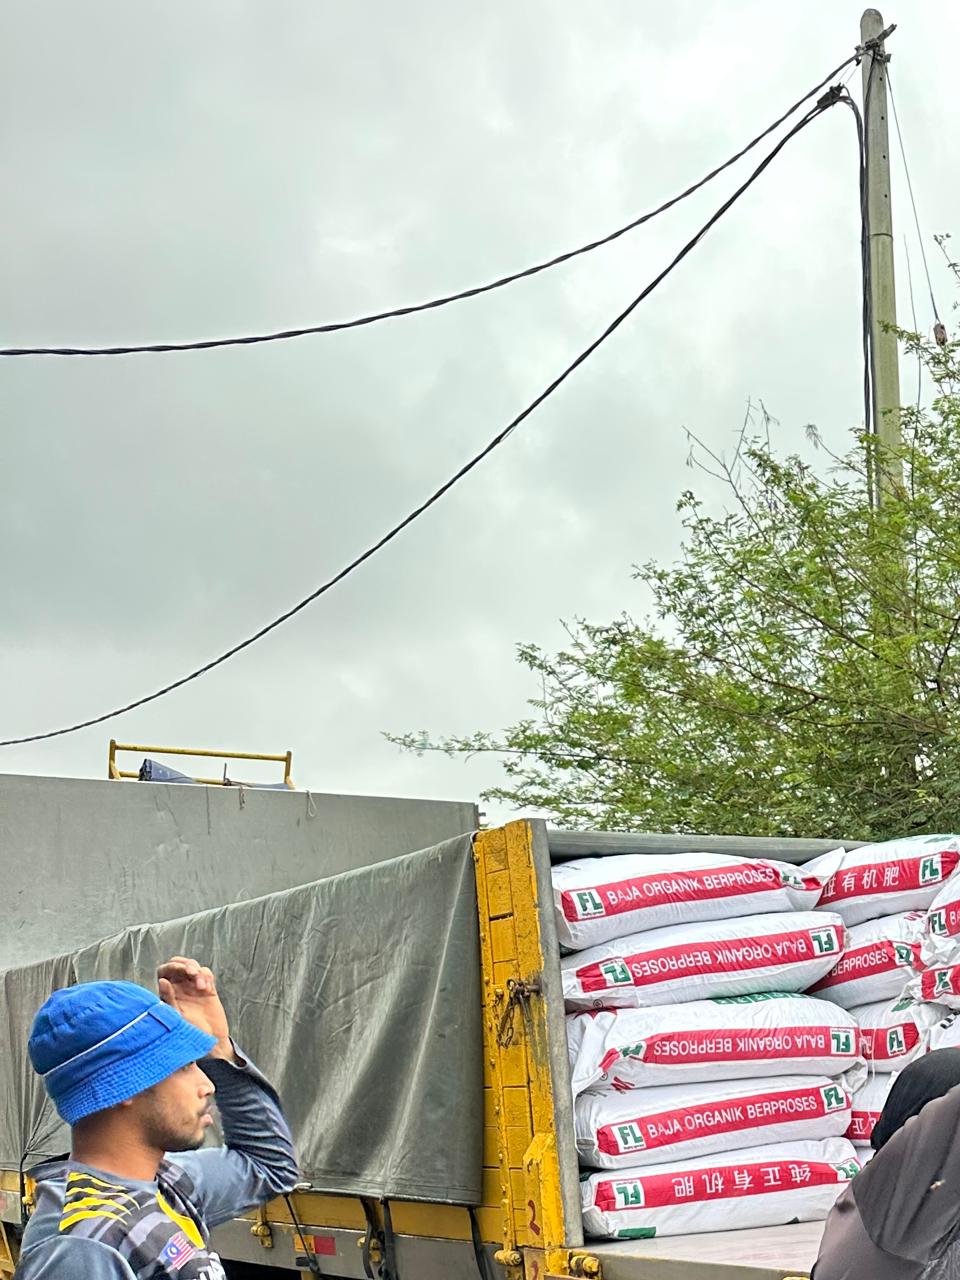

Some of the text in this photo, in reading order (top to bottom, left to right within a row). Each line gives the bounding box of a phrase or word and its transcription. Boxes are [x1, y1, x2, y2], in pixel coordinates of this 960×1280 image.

[921, 857, 940, 882] FL
[606, 868, 775, 905] BAJA ORGANIK BERPROSES
[577, 892, 603, 912] FL
[812, 932, 833, 953] FL
[634, 939, 806, 976] BAJA ORGANIK BERPROSES
[831, 949, 889, 976] BERPROSES
[604, 964, 632, 983] FL
[653, 1039, 733, 1056] BERPROSES
[736, 1037, 791, 1052] ORGANIK
[794, 1035, 825, 1048] BAJA
[831, 1033, 851, 1053] FL
[889, 1029, 903, 1051] FL
[824, 1087, 845, 1108] FL
[647, 1095, 818, 1139] BAJA ORGANIK BERPROSES
[617, 1125, 643, 1145] FL
[671, 1163, 811, 1198] 纯正有机肥
[617, 1184, 641, 1205] FL
